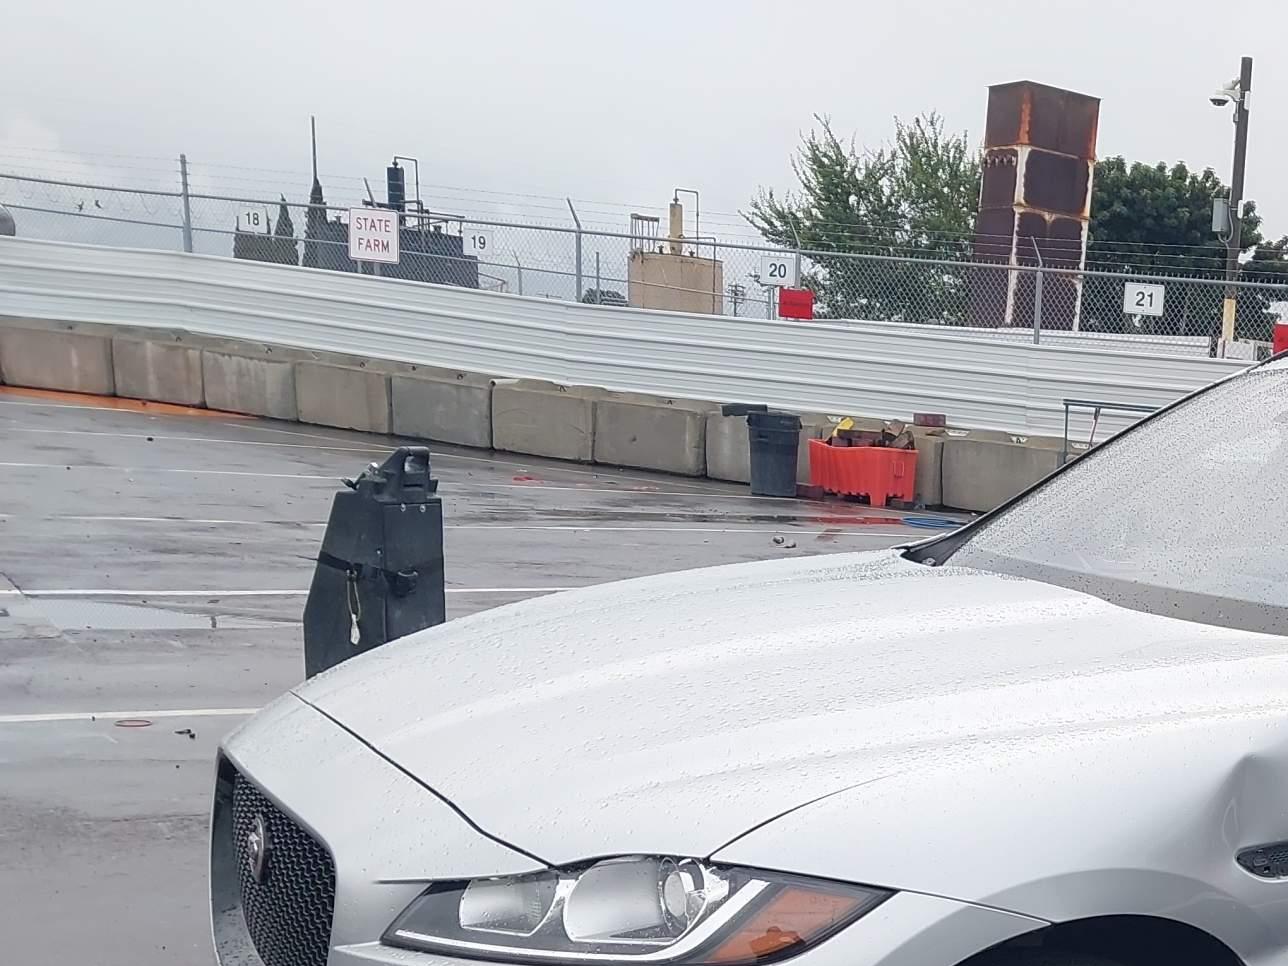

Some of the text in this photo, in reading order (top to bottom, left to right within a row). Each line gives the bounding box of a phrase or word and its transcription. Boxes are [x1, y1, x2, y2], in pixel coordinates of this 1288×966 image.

[245, 213, 260, 226] 18
[355, 217, 392, 233] STATE
[357, 237, 390, 253] FARM
[470, 235, 487, 250] 19
[769, 263, 787, 278] 20
[1135, 291, 1154, 308] 21
